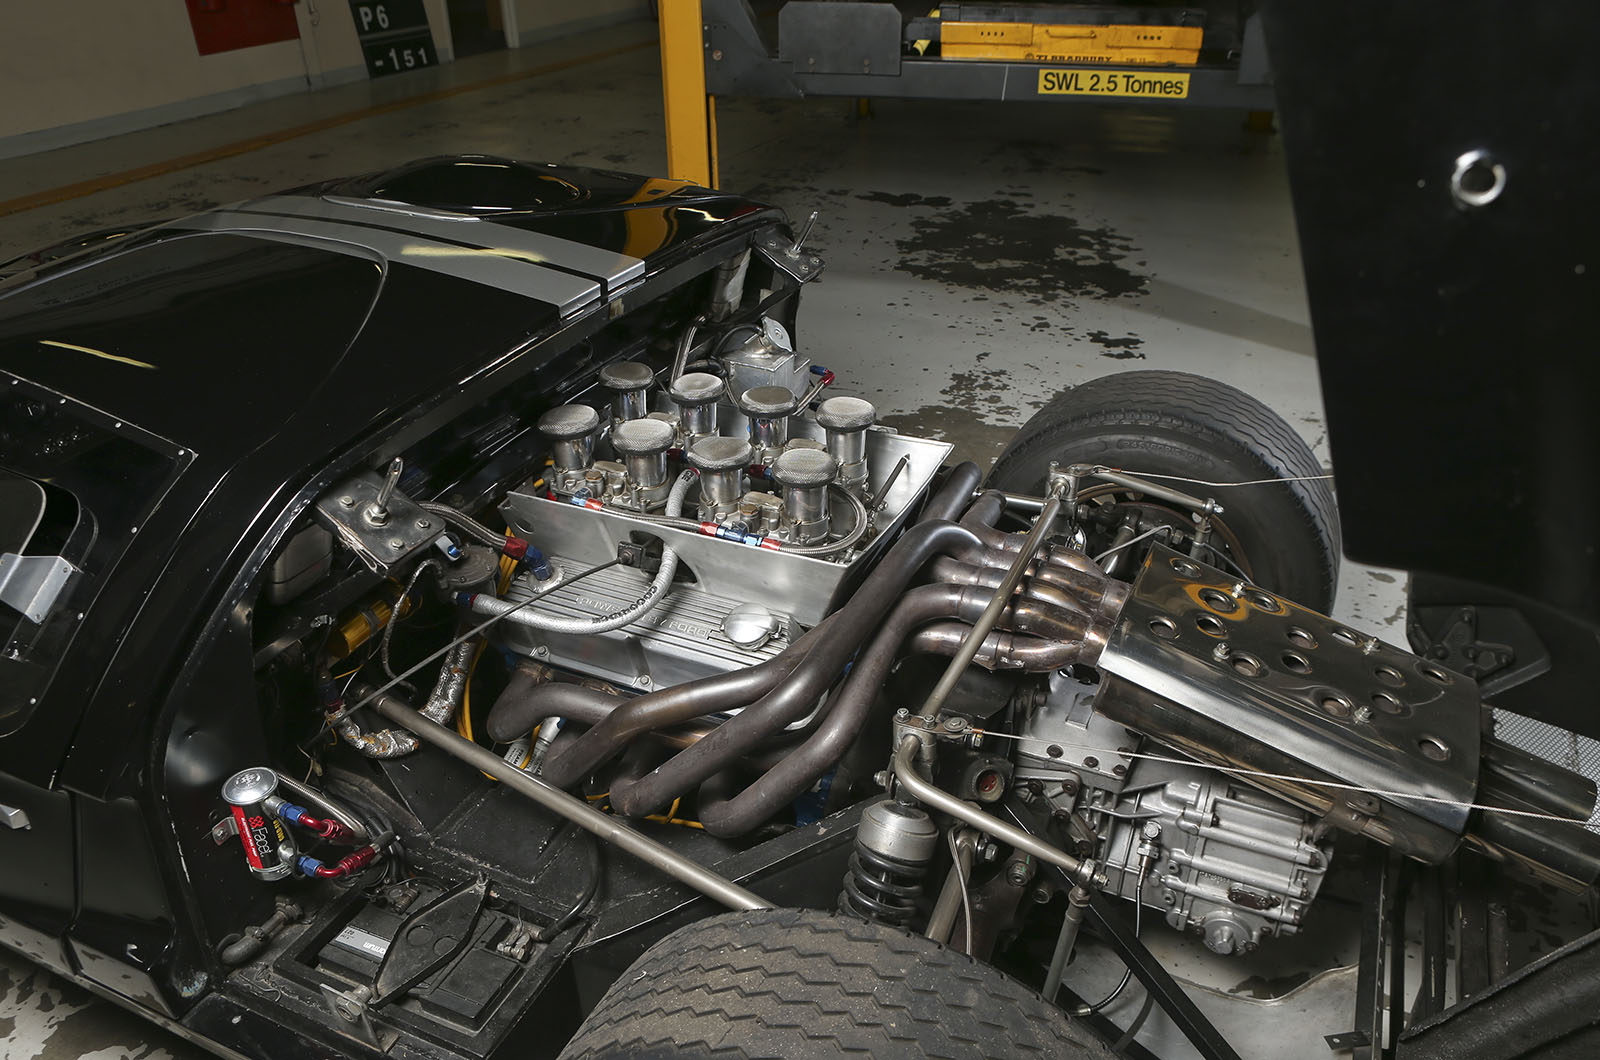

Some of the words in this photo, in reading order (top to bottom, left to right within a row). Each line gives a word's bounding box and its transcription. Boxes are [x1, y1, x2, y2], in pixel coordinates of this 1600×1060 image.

[1043, 72, 1083, 91] SWL
[1089, 74, 1118, 92] 2.5
[1123, 75, 1184, 95] Tonnes
[252, 827, 273, 856] Facet
